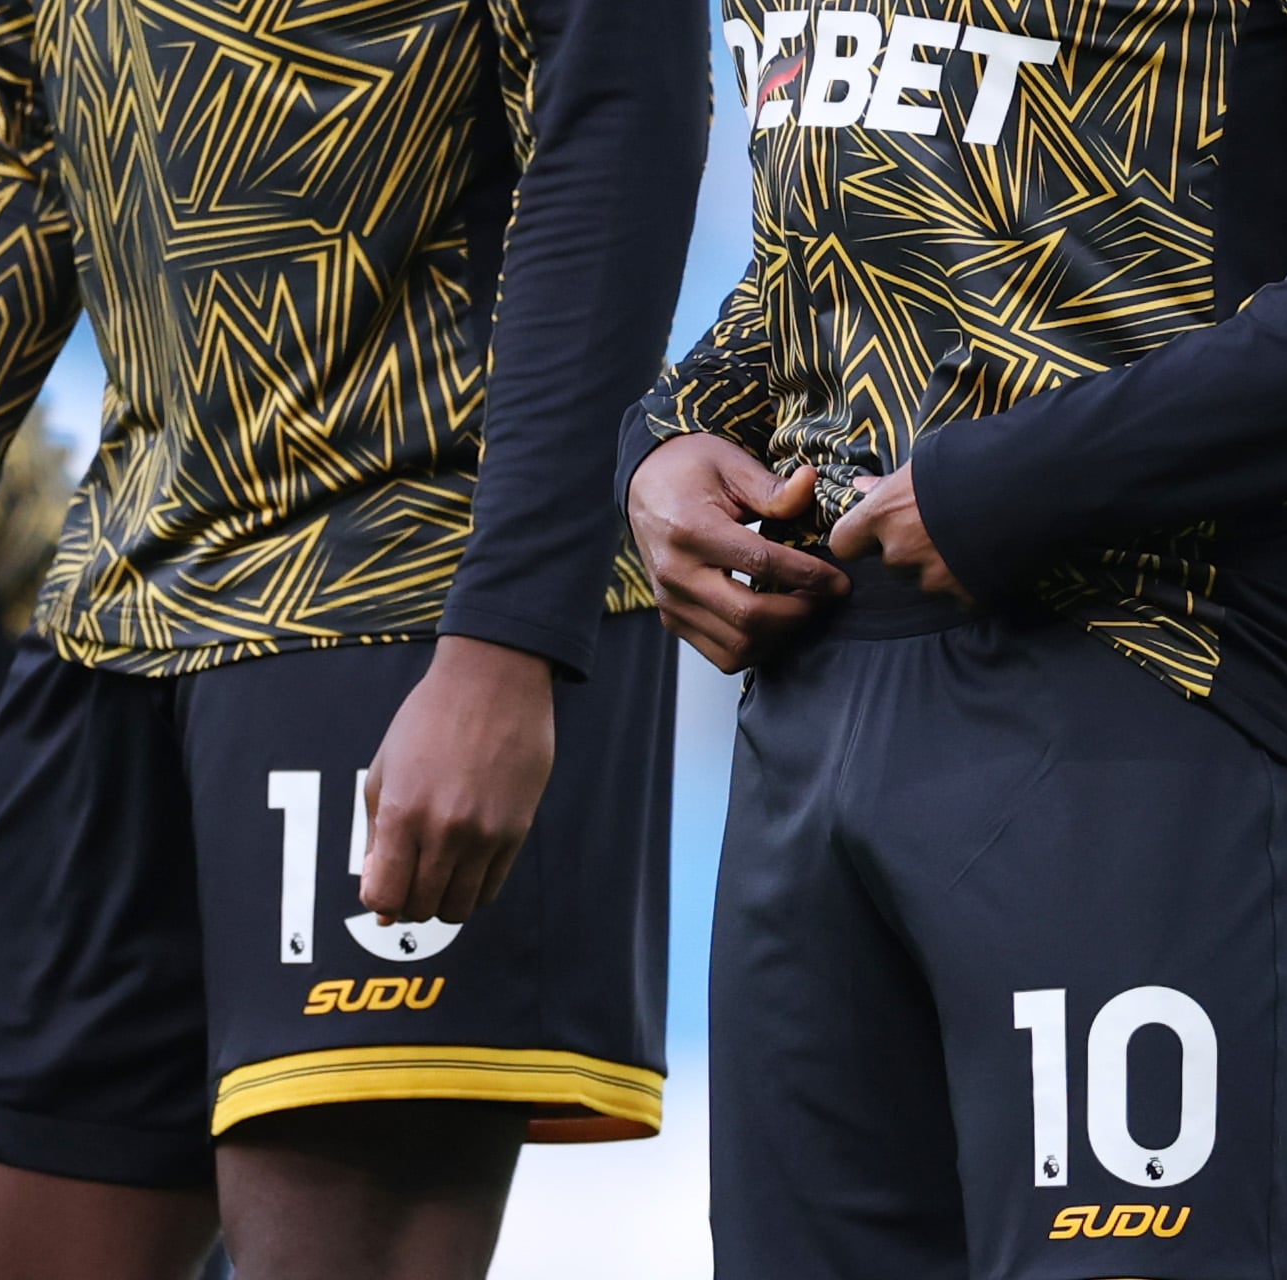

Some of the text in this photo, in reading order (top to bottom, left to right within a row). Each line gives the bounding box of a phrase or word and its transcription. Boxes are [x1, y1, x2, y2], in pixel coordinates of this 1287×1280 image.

[303, 976, 445, 1015] SUDU
[1013, 985, 1218, 1188] 10
[1048, 1204, 1191, 1239] SUDU
